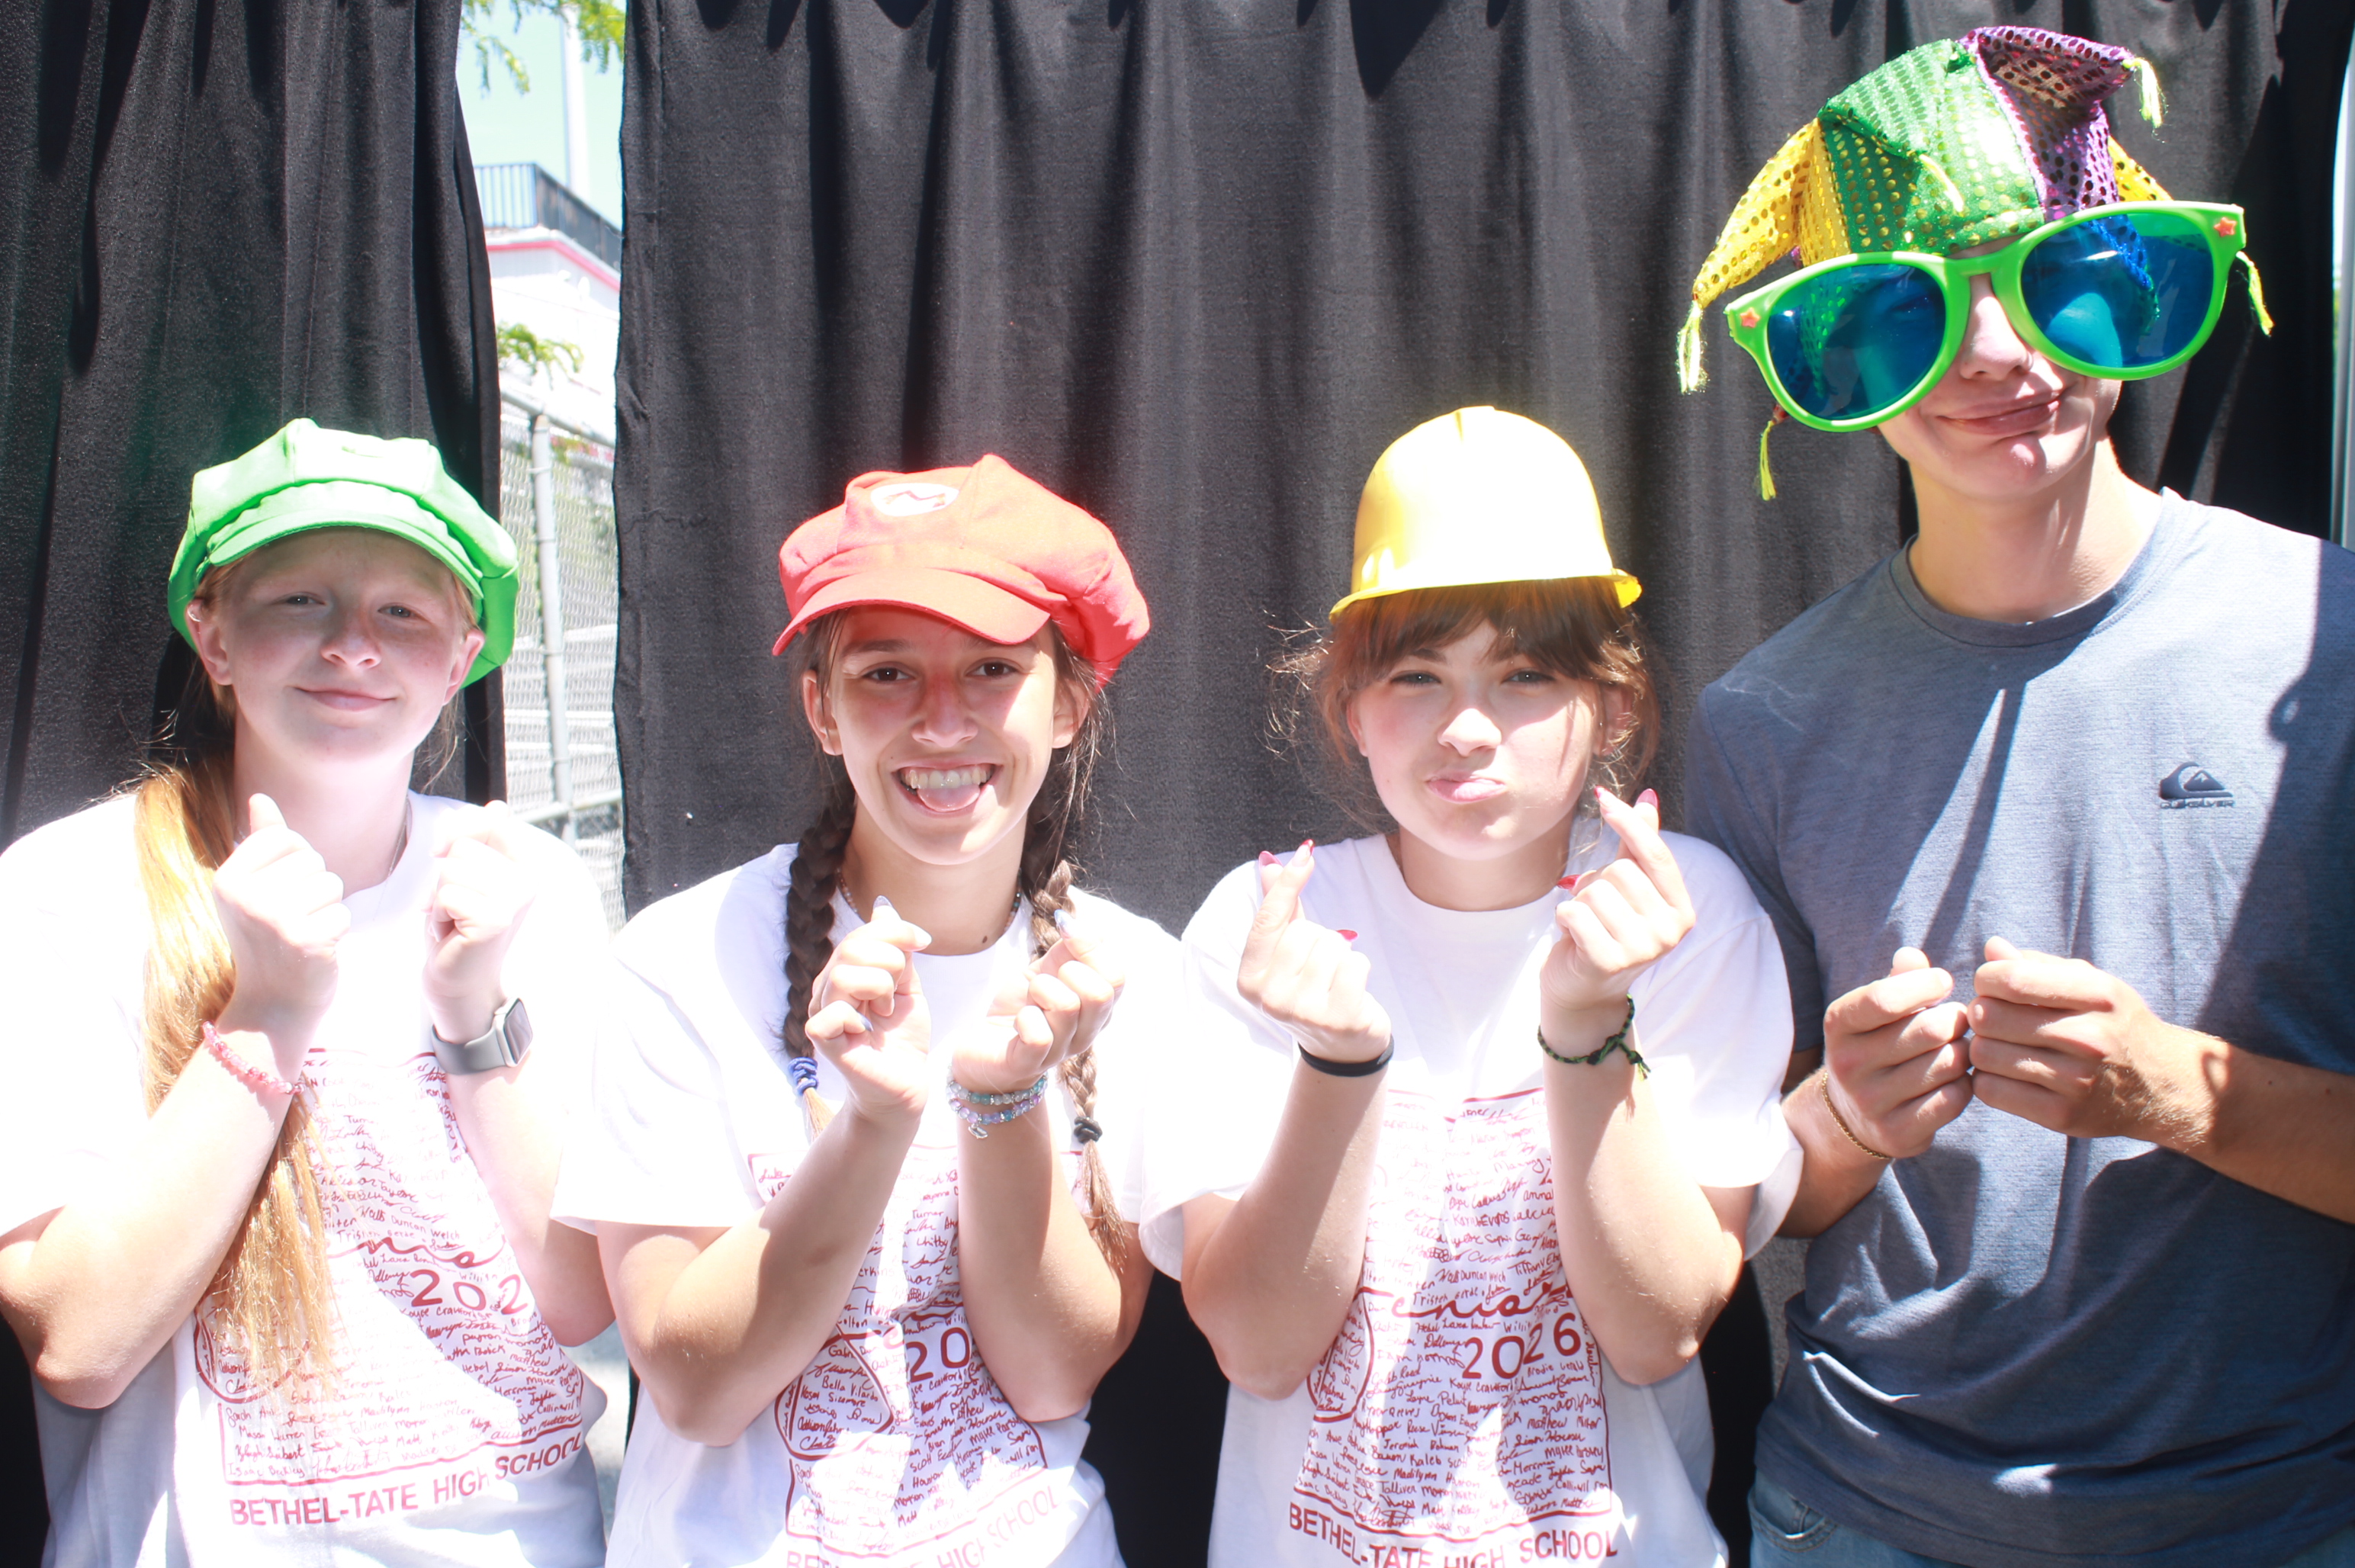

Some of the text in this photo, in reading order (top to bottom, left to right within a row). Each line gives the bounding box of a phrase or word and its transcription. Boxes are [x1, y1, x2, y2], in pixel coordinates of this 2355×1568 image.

[430, 1229, 461, 1239] Welch
[410, 1269, 529, 1316] 202
[858, 1266, 895, 1277] erkins
[905, 1326, 971, 1383] 20
[1462, 1313, 1582, 1380] 2026
[822, 1374, 846, 1391] Bella
[230, 1431, 583, 1526] BETHEL-TATE HIGH SCHOOL
[988, 1486, 1058, 1548] SCHOOL
[1290, 1501, 1434, 1568] BETHEL-TATE
[1520, 1528, 1618, 1563] SCHOOL
